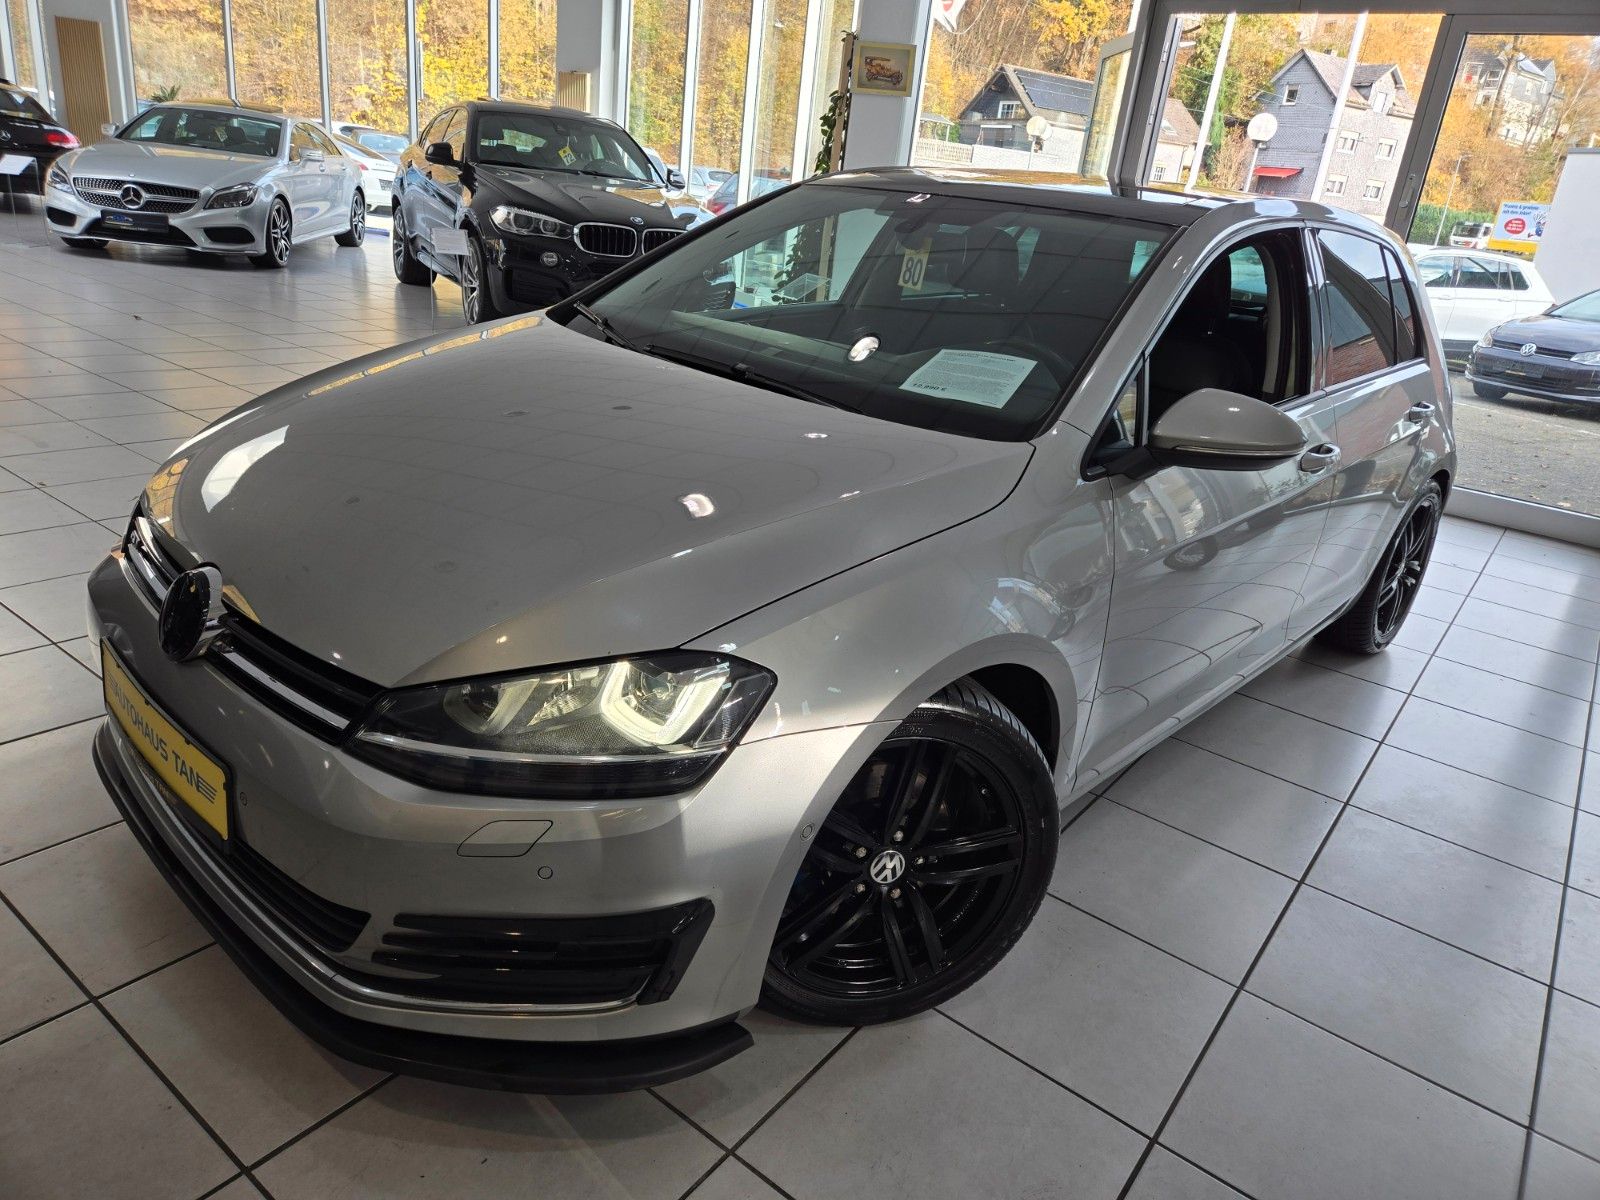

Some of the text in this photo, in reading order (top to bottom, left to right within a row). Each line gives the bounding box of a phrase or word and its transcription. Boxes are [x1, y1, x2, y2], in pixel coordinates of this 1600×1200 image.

[902, 256, 923, 286] 80
[115, 687, 168, 762] AUTOHAUS
[172, 750, 200, 793] TAN
